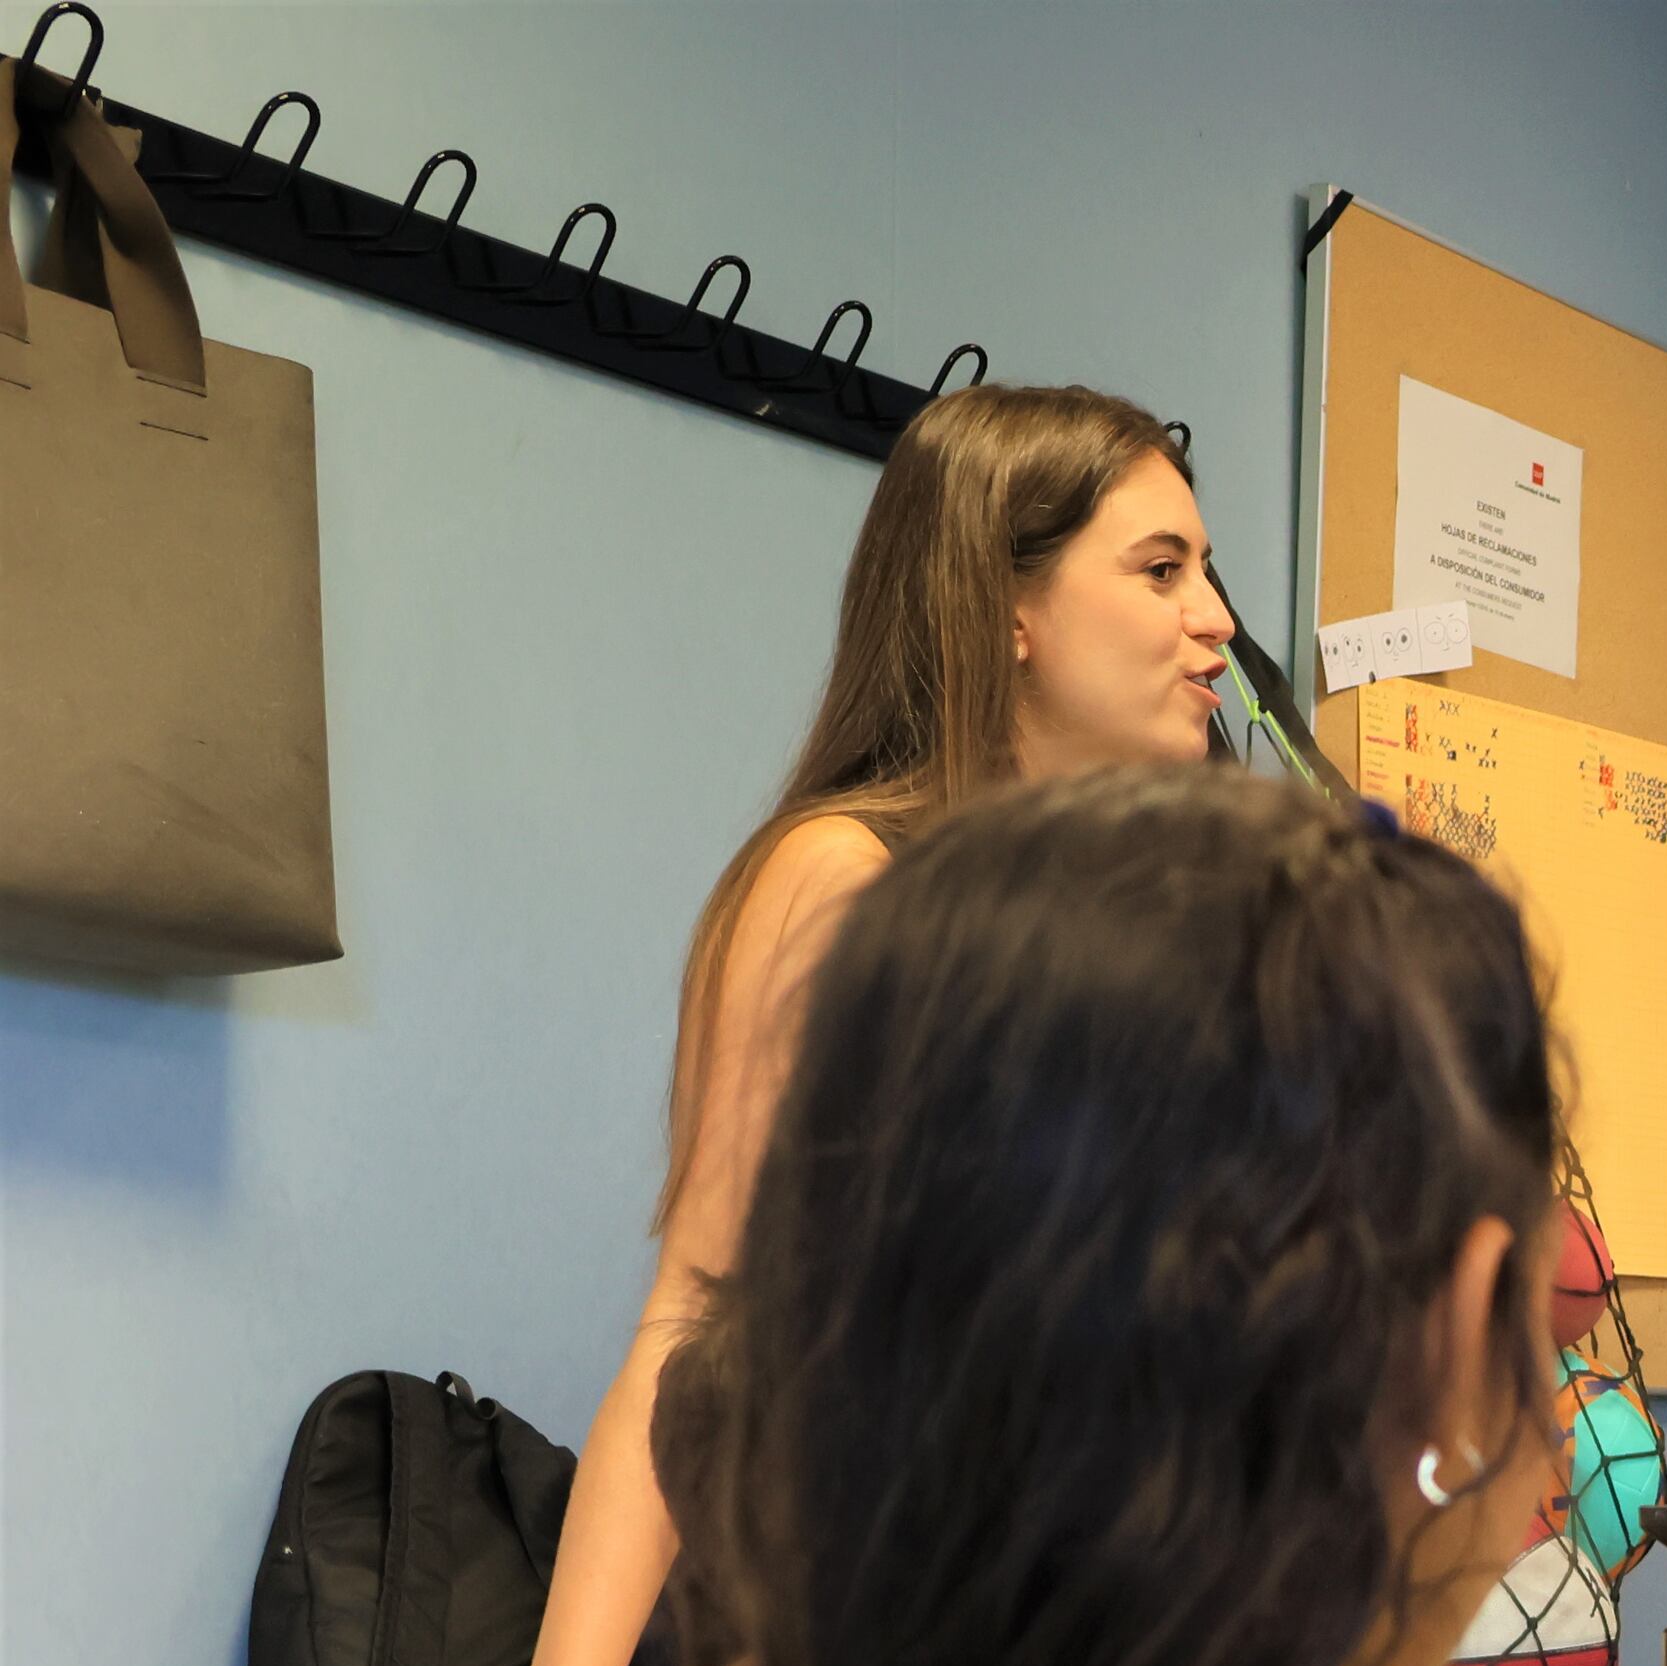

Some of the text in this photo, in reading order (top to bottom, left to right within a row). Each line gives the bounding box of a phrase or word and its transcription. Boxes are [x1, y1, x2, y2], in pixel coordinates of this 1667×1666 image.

[1476, 500, 1506, 520] EXISTEN
[1441, 523, 1537, 567] HOJAS DE RECLAMACIONES
[1437, 556, 1483, 581] DISPOSICIÓN
[1484, 572, 1498, 587] DEL
[1499, 578, 1545, 603] CONSUMIDOR
